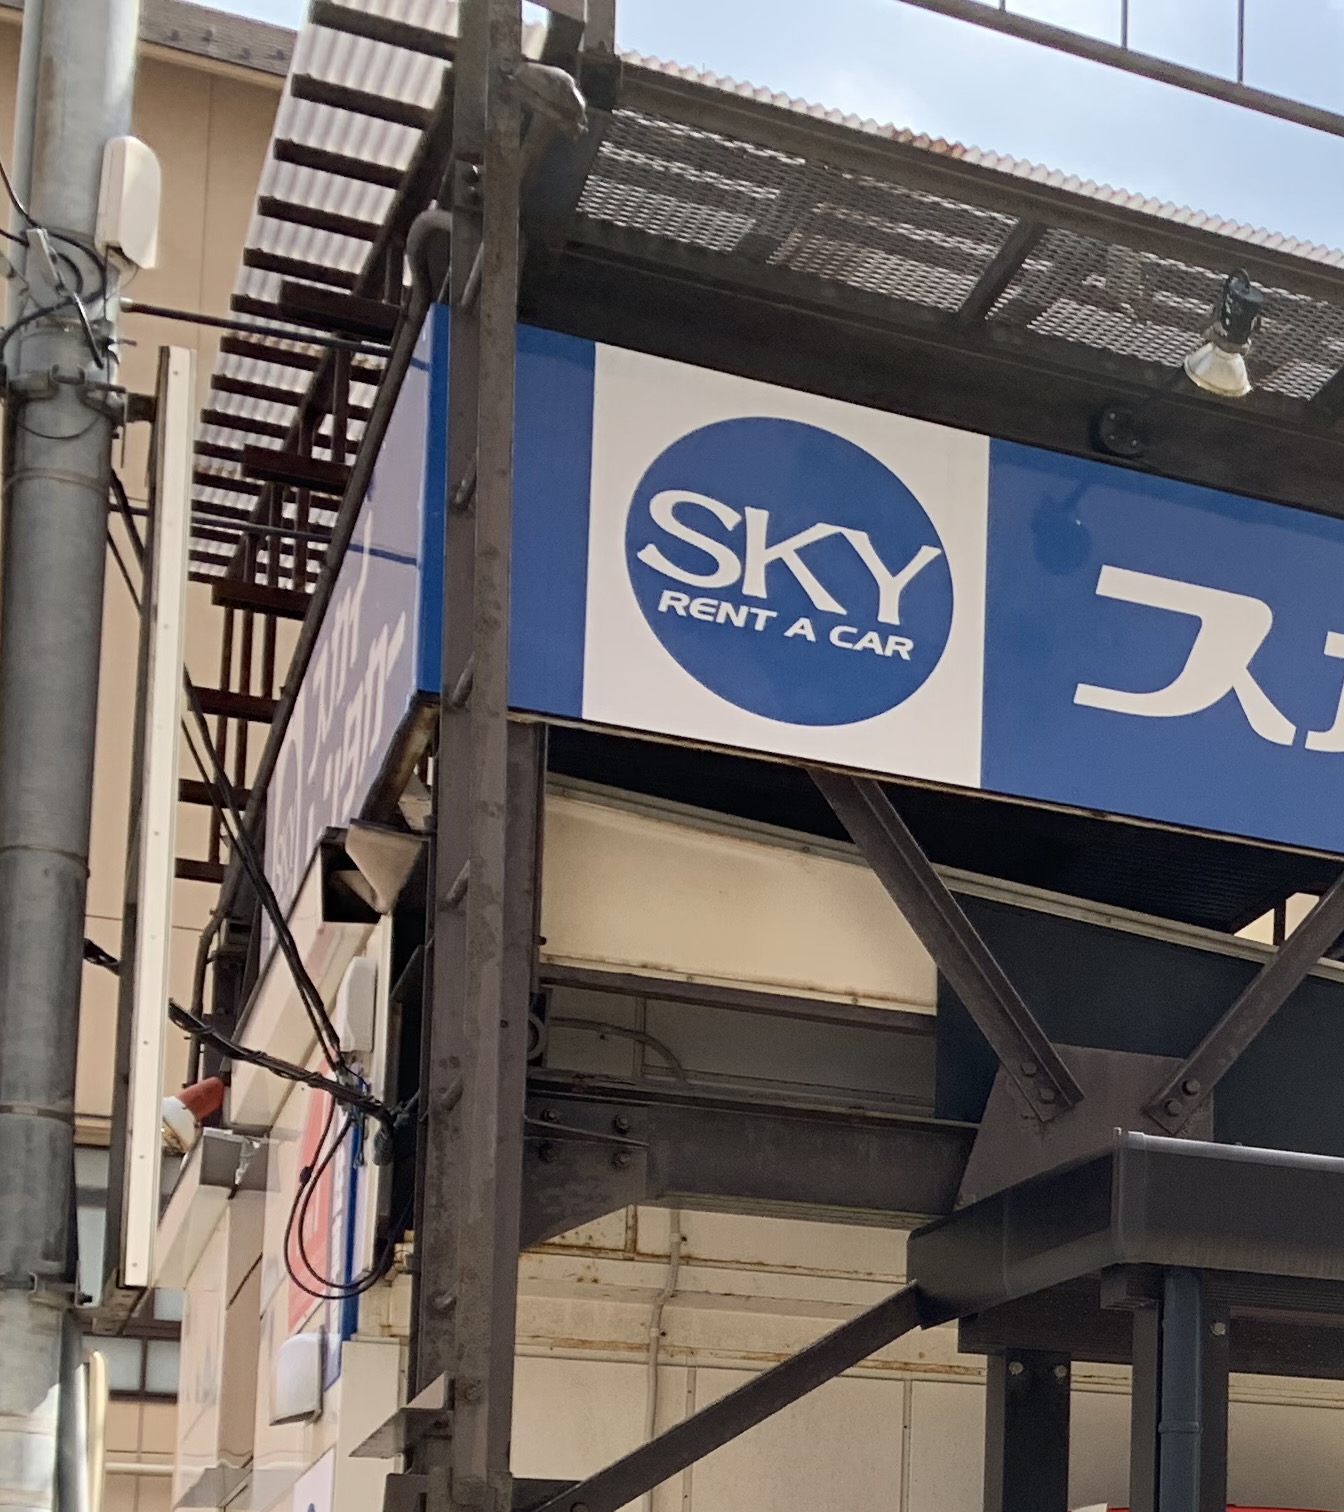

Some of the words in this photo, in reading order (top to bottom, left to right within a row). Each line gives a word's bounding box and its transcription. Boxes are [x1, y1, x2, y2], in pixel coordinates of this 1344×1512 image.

[637, 489, 942, 626] SKY
[658, 590, 777, 632] RENT
[784, 617, 816, 642] A
[829, 625, 914, 661] CAR
